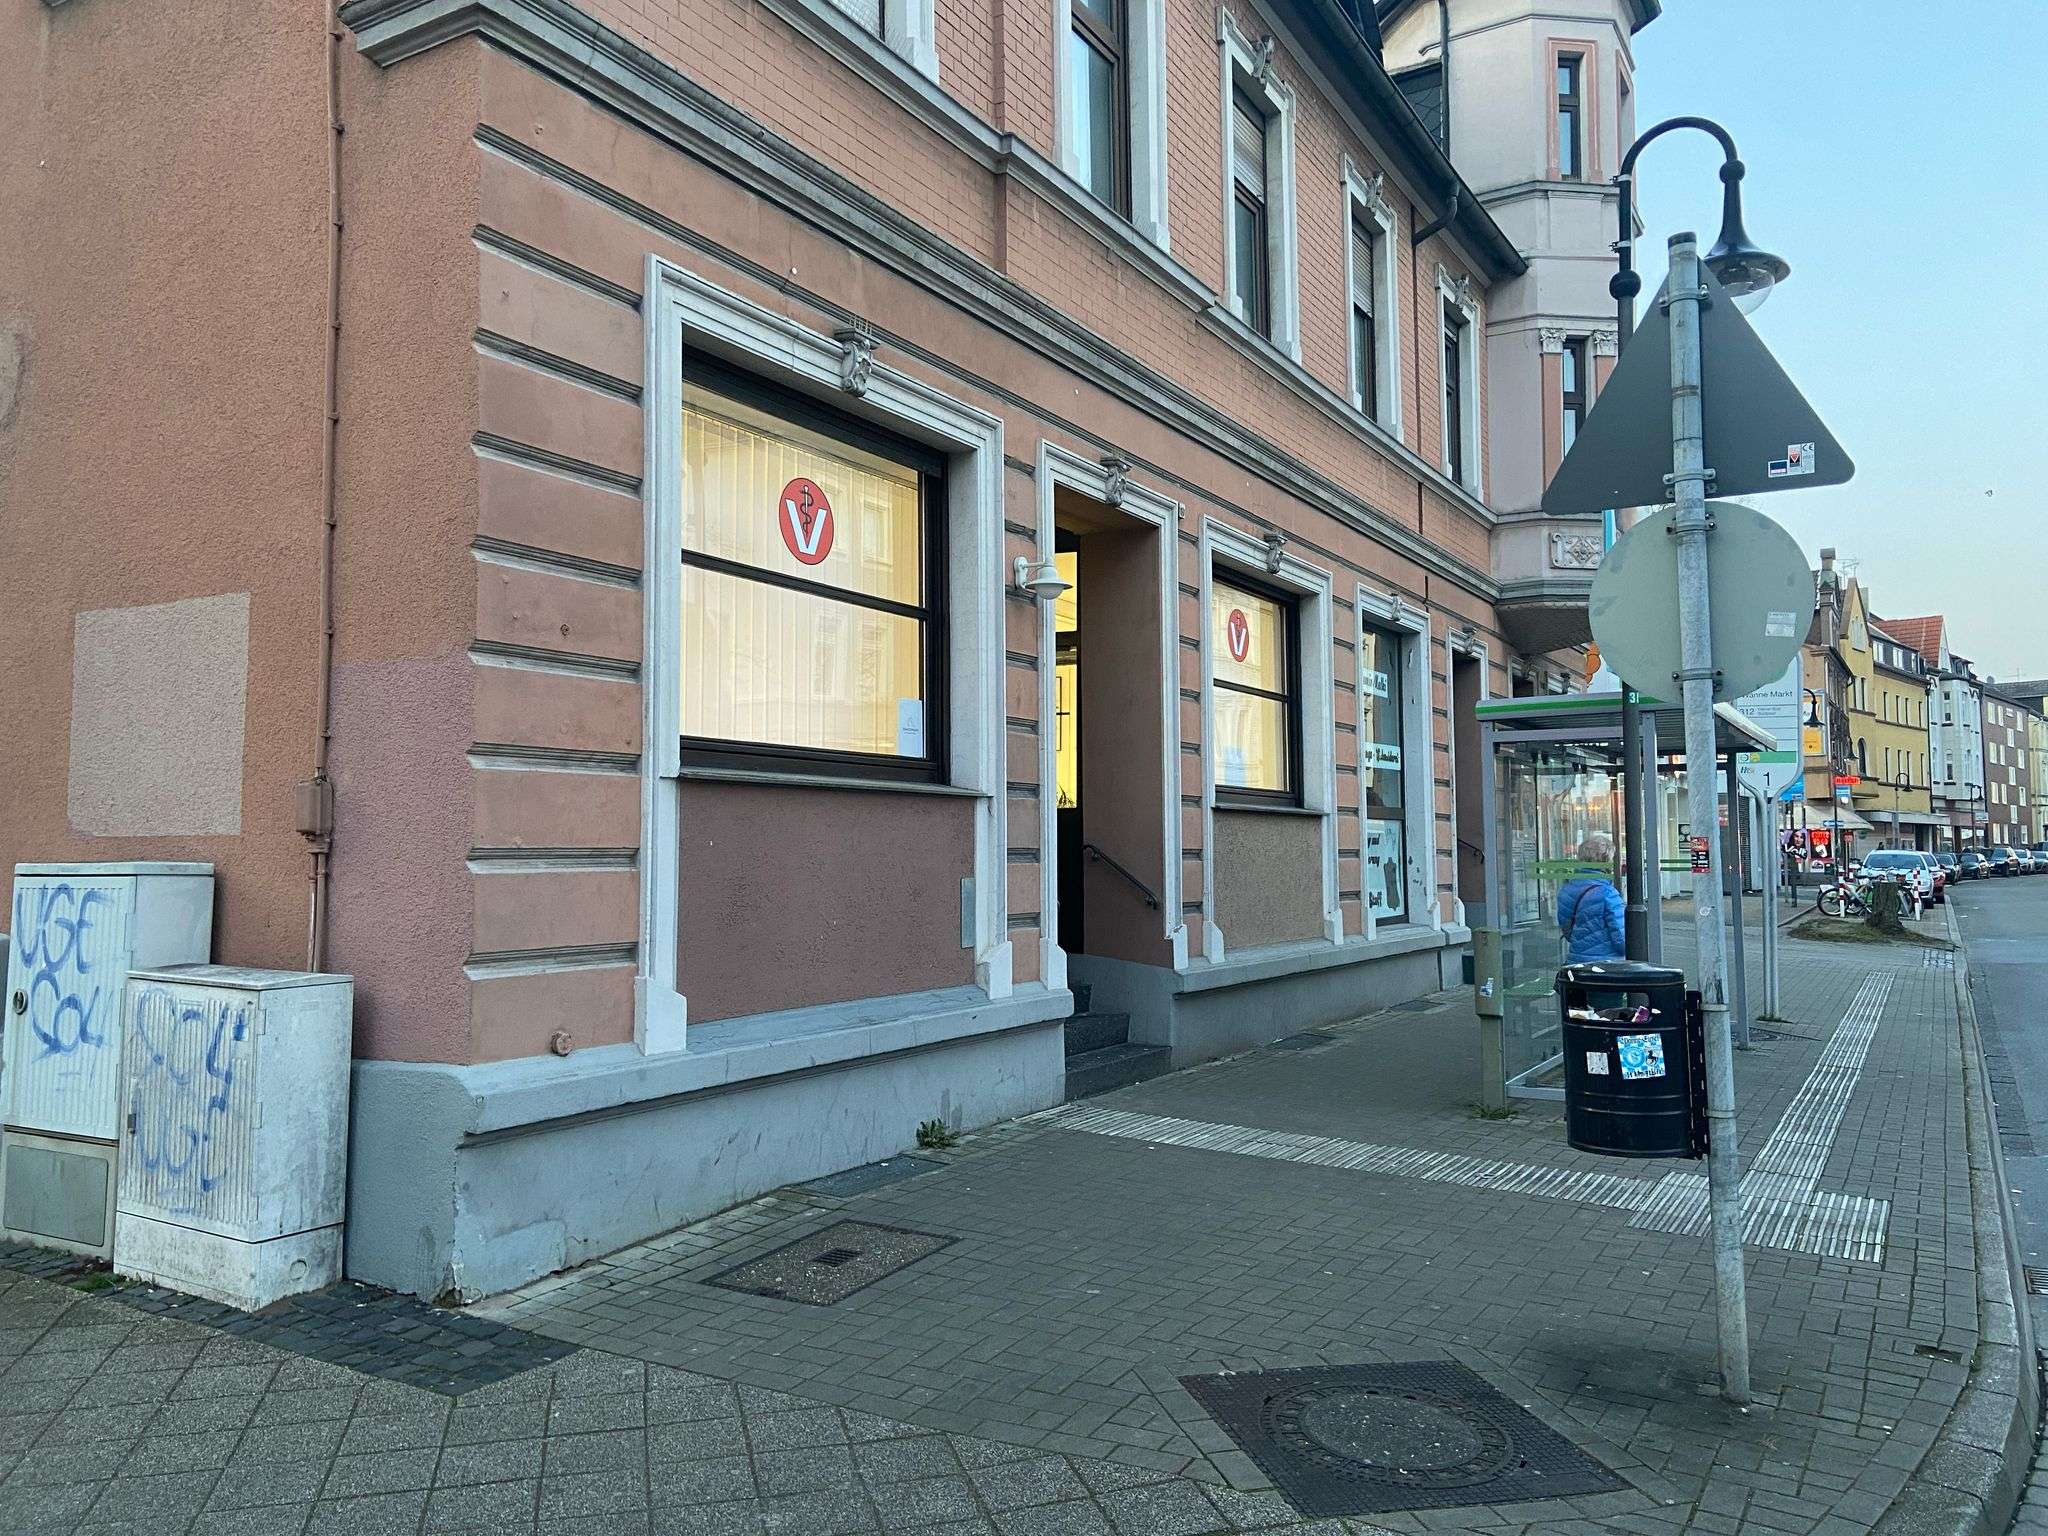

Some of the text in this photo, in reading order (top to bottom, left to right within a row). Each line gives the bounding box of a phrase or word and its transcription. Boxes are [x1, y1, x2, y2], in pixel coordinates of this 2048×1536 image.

[785, 498, 828, 556] V
[1230, 621, 1247, 657] V
[1770, 689, 1793, 698] Markt
[1762, 771, 1771, 787] 1
[1784, 843, 1808, 859] Volt
